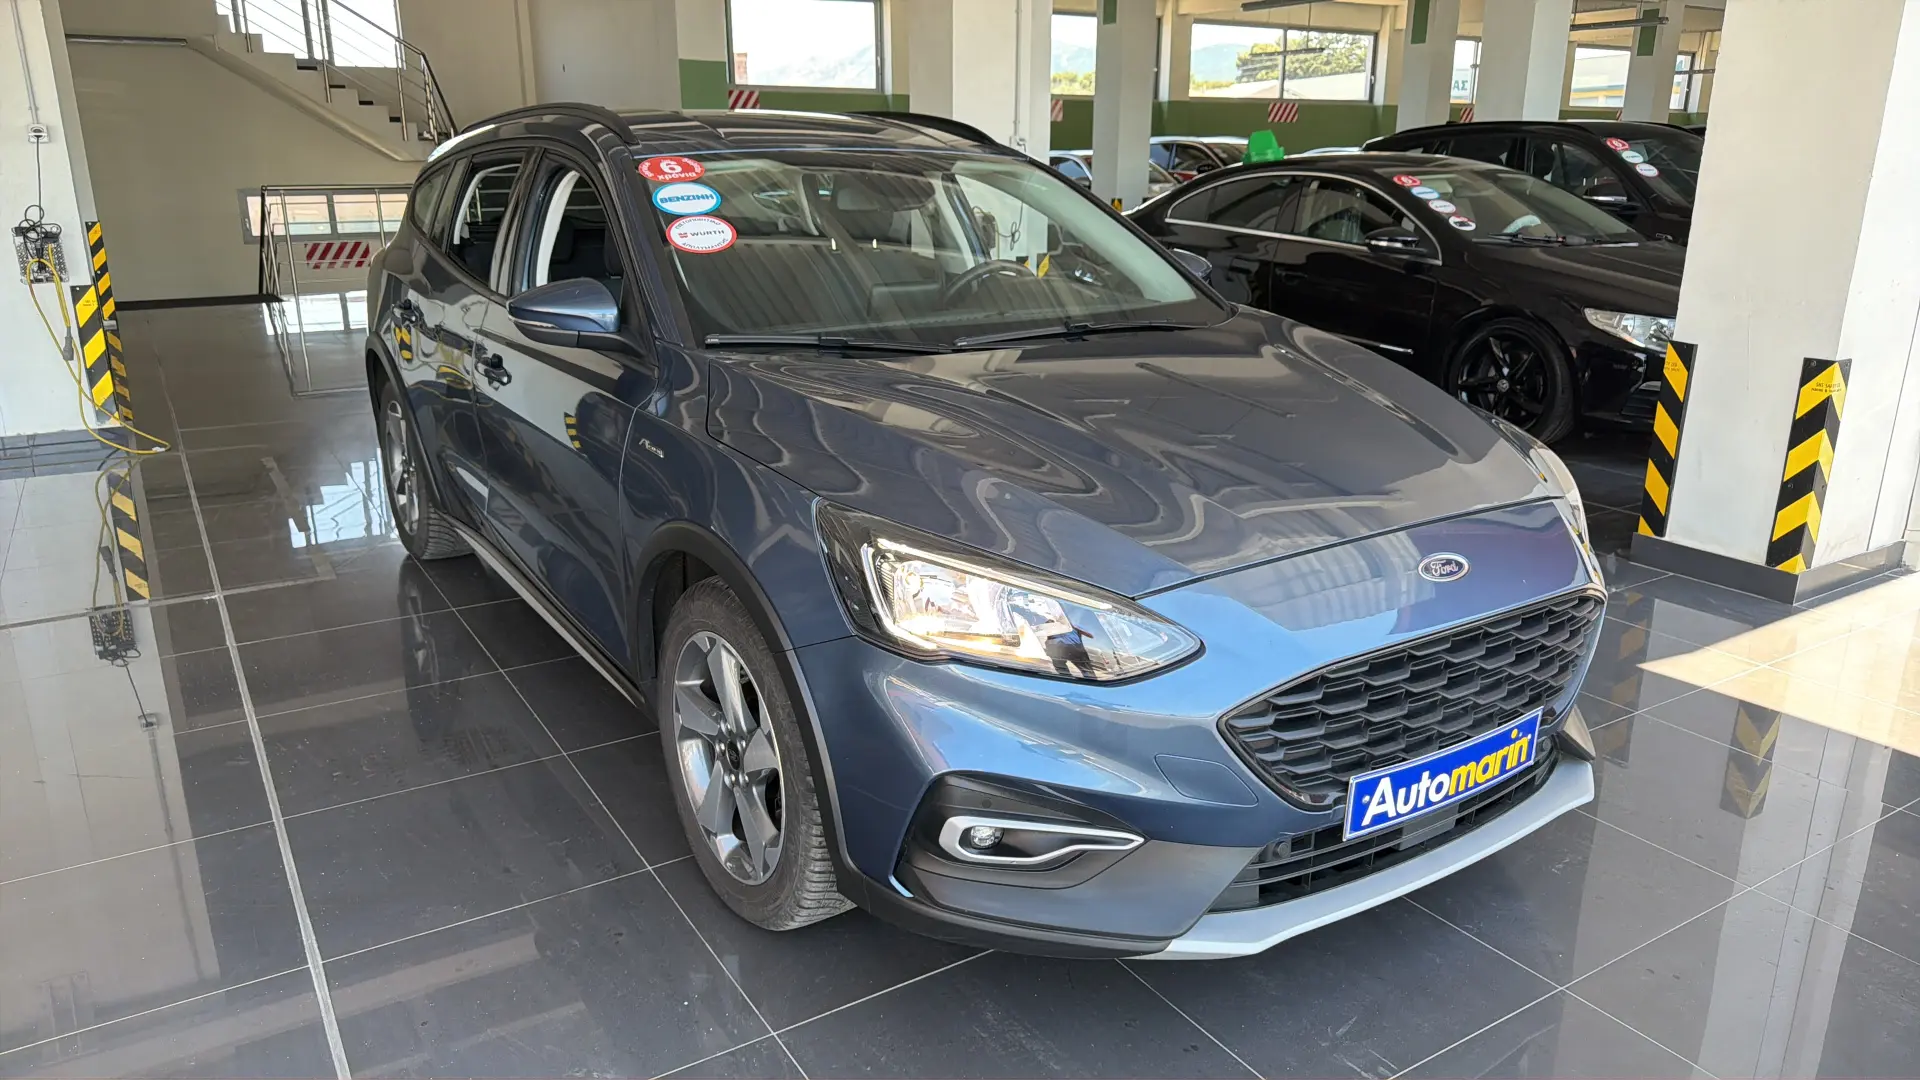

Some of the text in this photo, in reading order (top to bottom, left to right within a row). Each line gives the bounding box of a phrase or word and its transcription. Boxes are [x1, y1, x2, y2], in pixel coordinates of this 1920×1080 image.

[660, 159, 682, 174] 6
[659, 194, 714, 203] ΒΕΝΖΙΝΗ
[1430, 560, 1459, 577] Ford
[1361, 728, 1531, 826] Automarin
